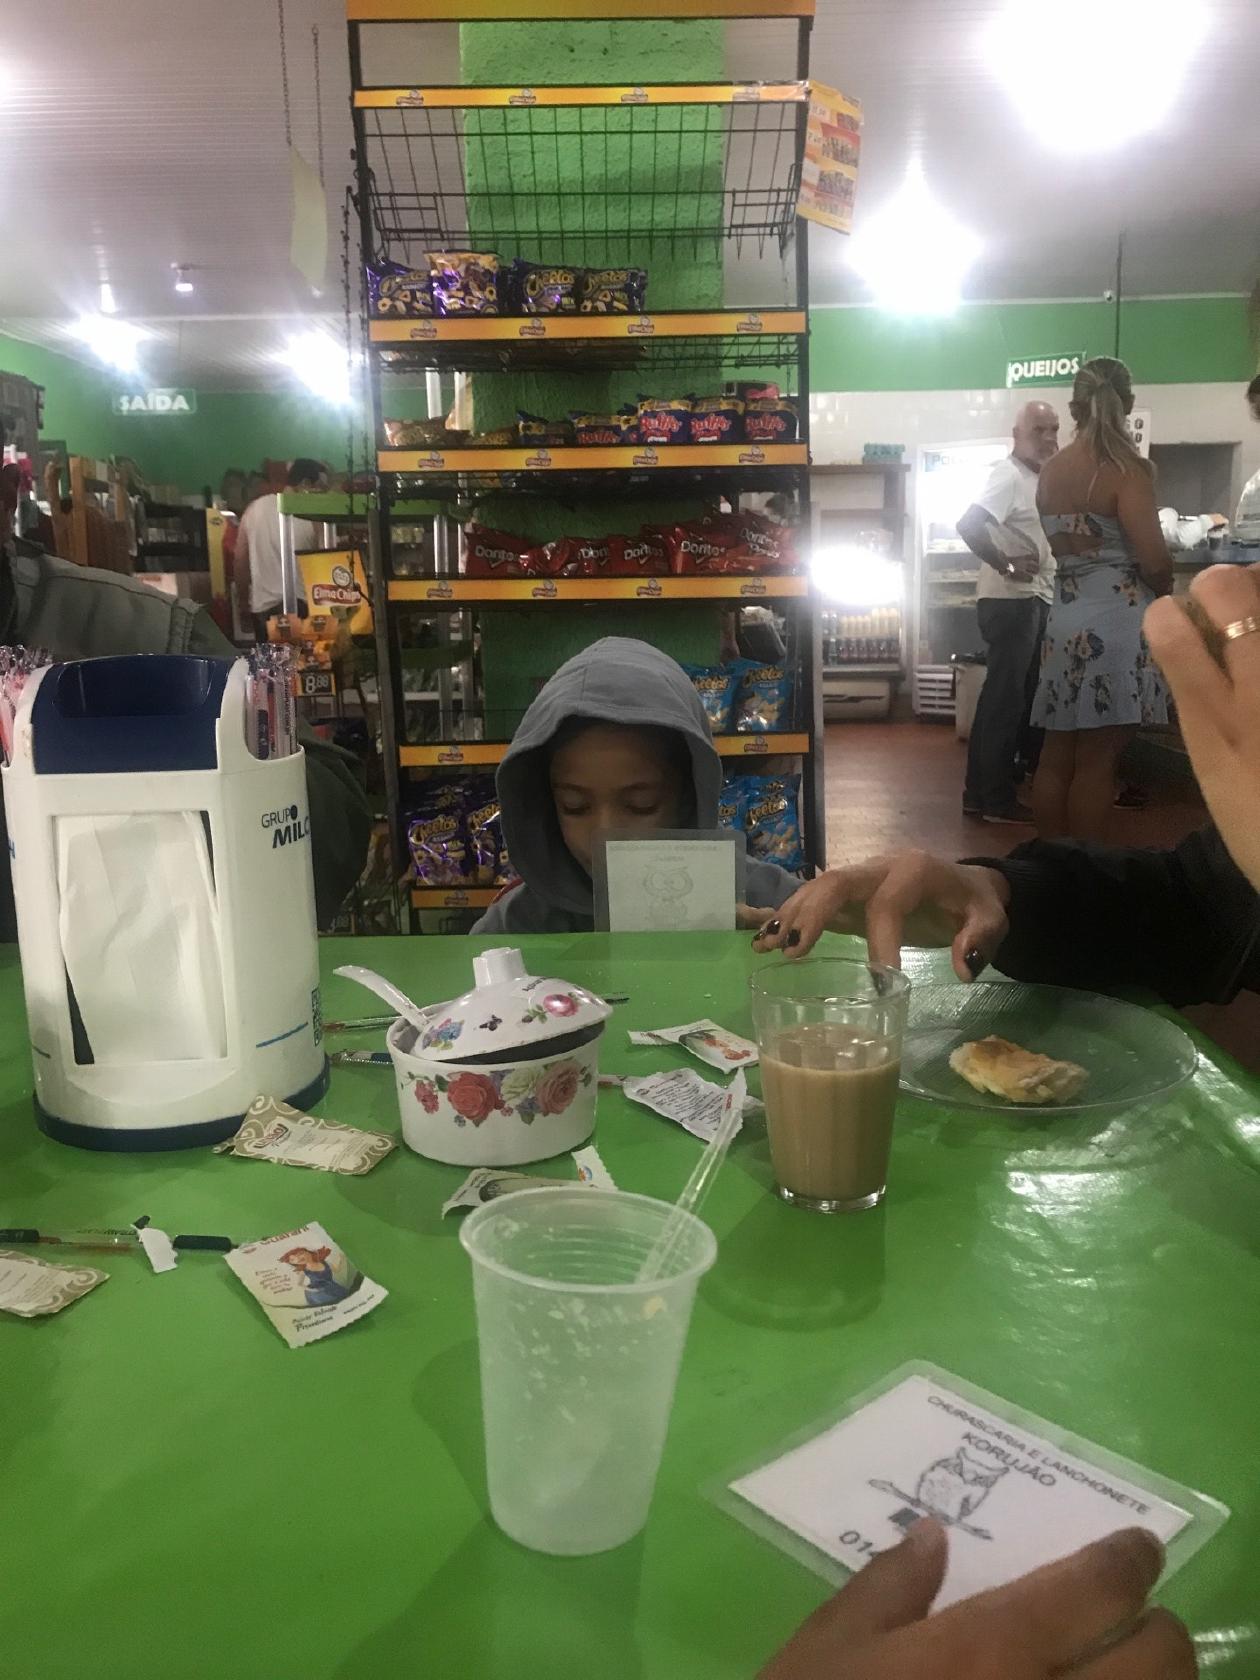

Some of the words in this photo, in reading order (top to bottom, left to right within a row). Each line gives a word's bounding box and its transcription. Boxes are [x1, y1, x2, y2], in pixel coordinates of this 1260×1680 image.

[1011, 357, 1080, 382] QUEIJOS
[261, 804, 298, 828] GRUPO
[928, 1395, 1026, 1451] CHURASCARIA
[1027, 1449, 1040, 1460] E
[1041, 1456, 1151, 1515] LANCHONETE
[961, 1431, 1057, 1487] KORUJÃO
[839, 1530, 884, 1558] 01
